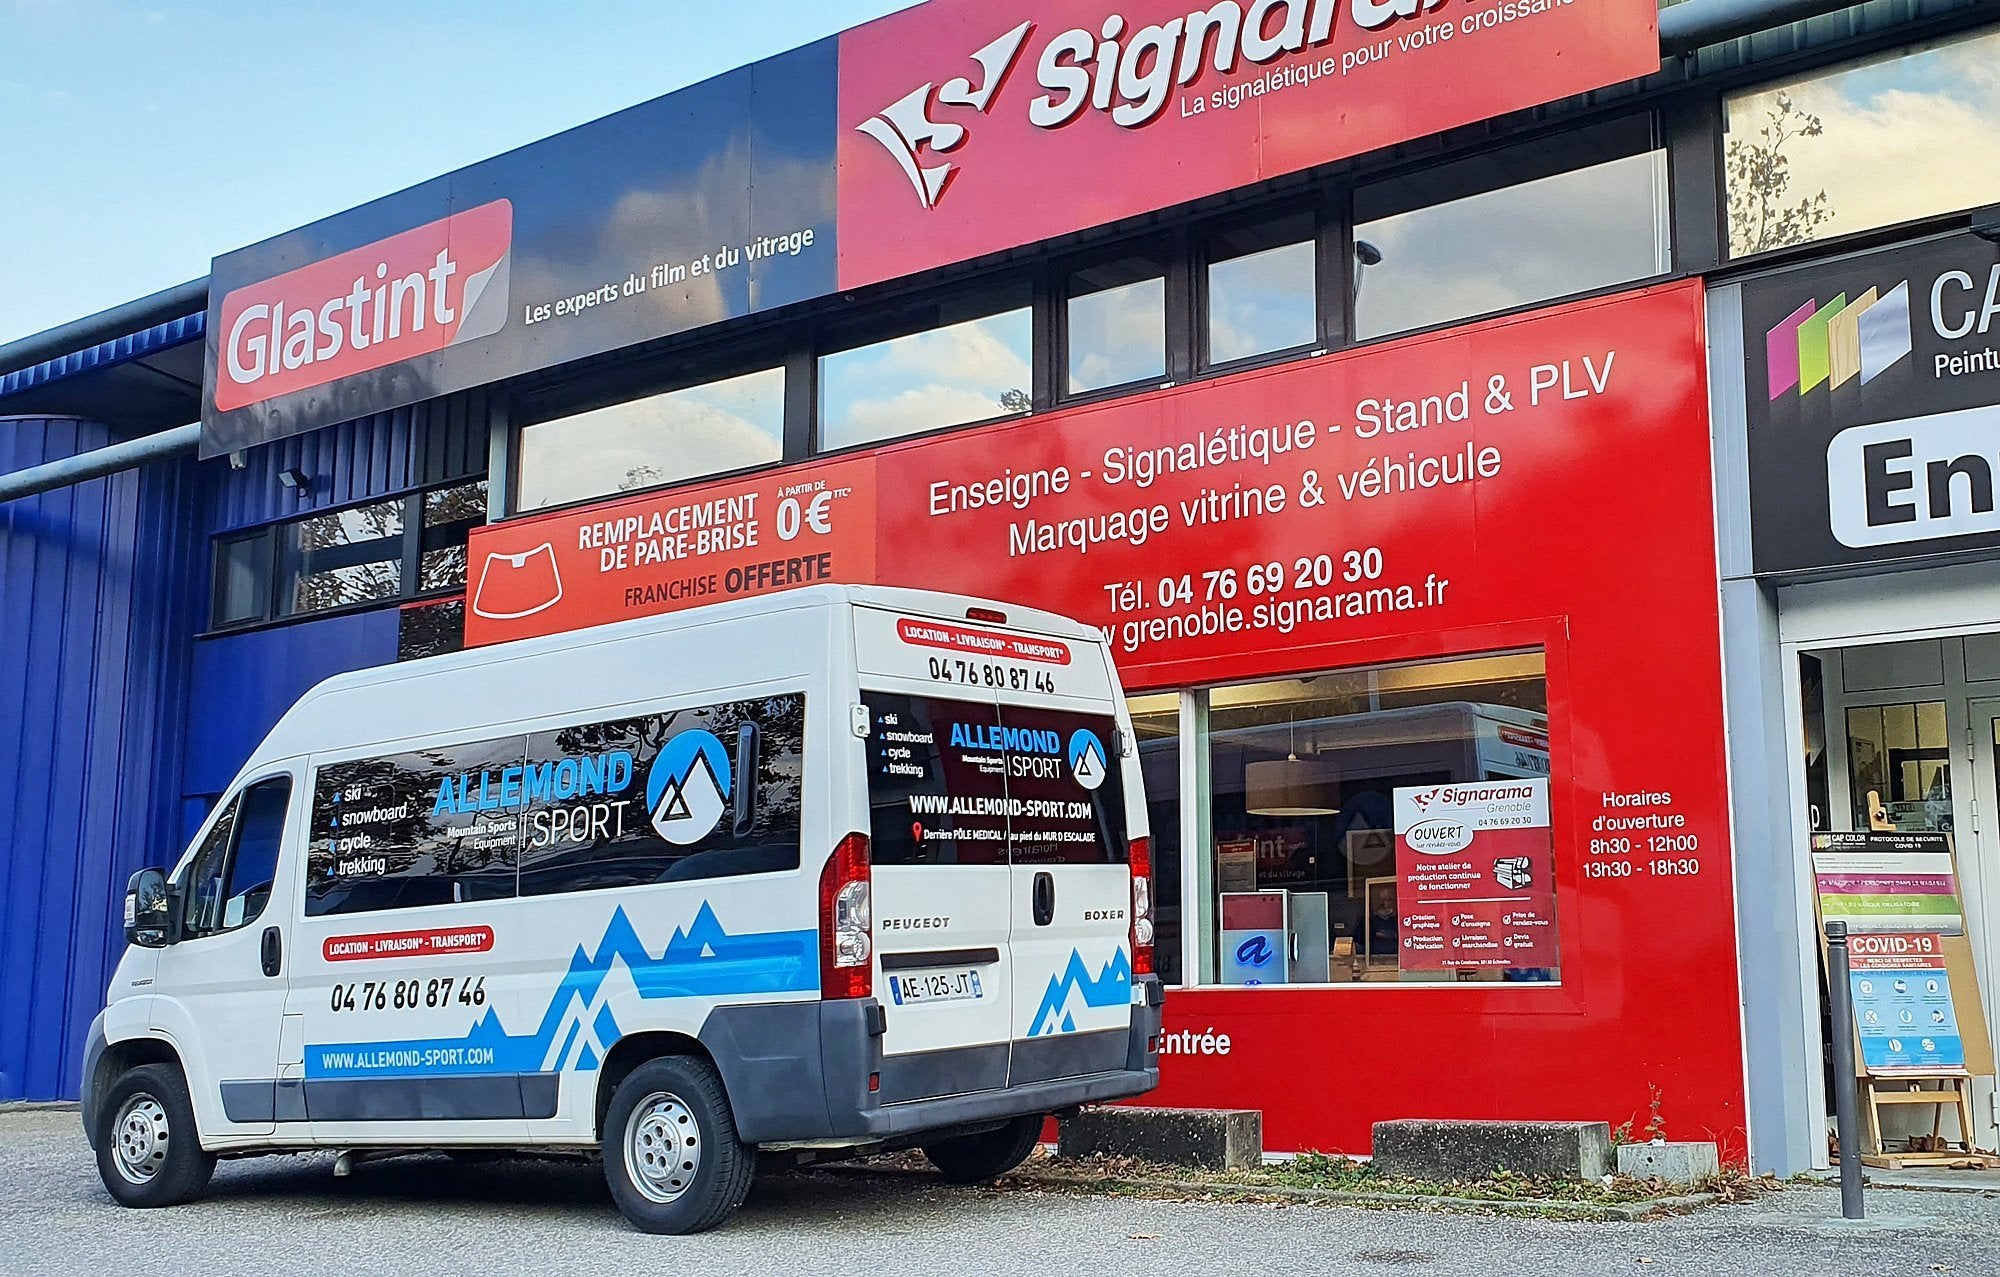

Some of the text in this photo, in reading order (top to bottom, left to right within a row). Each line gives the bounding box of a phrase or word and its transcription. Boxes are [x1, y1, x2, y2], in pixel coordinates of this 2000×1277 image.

[1181, 96, 1205, 118] La
[1211, 57, 1335, 110] signalétique
[1342, 38, 1392, 76] pour
[1398, 22, 1454, 53] votre
[525, 229, 814, 325] Les experts du film et du vitrage
[227, 247, 456, 384] Glastint
[930, 466, 1070, 516] Enseigne
[1103, 419, 1316, 488] Signalétique
[1355, 380, 1469, 439] Stand
[1483, 374, 1514, 415] &
[1530, 351, 1616, 406] PLV
[785, 483, 812, 497] PARTIR
[814, 480, 826, 491] DE
[1863, 438, 2000, 527] En
[1009, 441, 1501, 557] Marquage vitrine & véhicule
[579, 493, 759, 550] REMPLACEMENT
[600, 521, 759, 572] DE PARE-BRISE
[624, 552, 832, 607] FRANCHISE OFFERTE
[1104, 547, 1383, 613] Tél. 04 76 69 20 30
[1123, 573, 1449, 652] grenoble.signarama.fr
[904, 625, 950, 643] LOCATION
[929, 657, 1055, 694] 04 76 80 87 46
[885, 713, 898, 725] ski
[886, 731, 933, 744] snowboard
[950, 723, 1060, 754] ALLEMOND
[888, 747, 911, 760] cycle
[889, 763, 923, 778] trekking
[1013, 756, 1061, 778] SPORT
[344, 784, 362, 802] ski
[432, 751, 633, 817] ALLEMOND
[1442, 786, 1533, 806] Signarama
[1602, 789, 1672, 808] Horaires
[342, 801, 407, 826] snowboard
[909, 795, 1092, 819] WWW.ALLEMOND-SPORT.COM
[1486, 801, 1531, 814] Grenoble
[447, 819, 517, 838] Mountain Sports
[531, 800, 630, 847] SPORT
[1478, 815, 1532, 827] 04 76 69 20 30
[1592, 813, 1685, 832] d'ouverture
[474, 834, 516, 851] Equipment
[924, 829, 952, 840] Derrière
[953, 828, 972, 840] PÔLE
[973, 830, 1002, 840] MEDICAL
[1019, 831, 1033, 842] pied
[1034, 832, 1042, 841] du
[1043, 832, 1058, 841] MUR
[1064, 833, 1095, 842] ESCALADE
[1414, 825, 1464, 841] OUVERT
[340, 832, 371, 855] cycle
[1590, 837, 1630, 854] 8h30
[1647, 834, 1698, 852] 12h00
[339, 856, 386, 876] trekking
[1416, 862, 1472, 872] Notre atelier de
[1582, 861, 1632, 878] 13h30
[1648, 858, 1699, 876] 18h30
[1408, 872, 1482, 883] production continue
[1418, 882, 1471, 891] de fonctionner
[882, 917, 951, 931] PEUGEOT
[1084, 909, 1125, 921] BOXER
[329, 942, 368, 956] LOCATION
[1852, 937, 1933, 954] COVID-19
[331, 976, 485, 1012] 04 76 80 87 46
[902, 974, 969, 998] AE-125-JT
[322, 1047, 494, 1070] WWW.ALLEMOND-SPORT.COM
